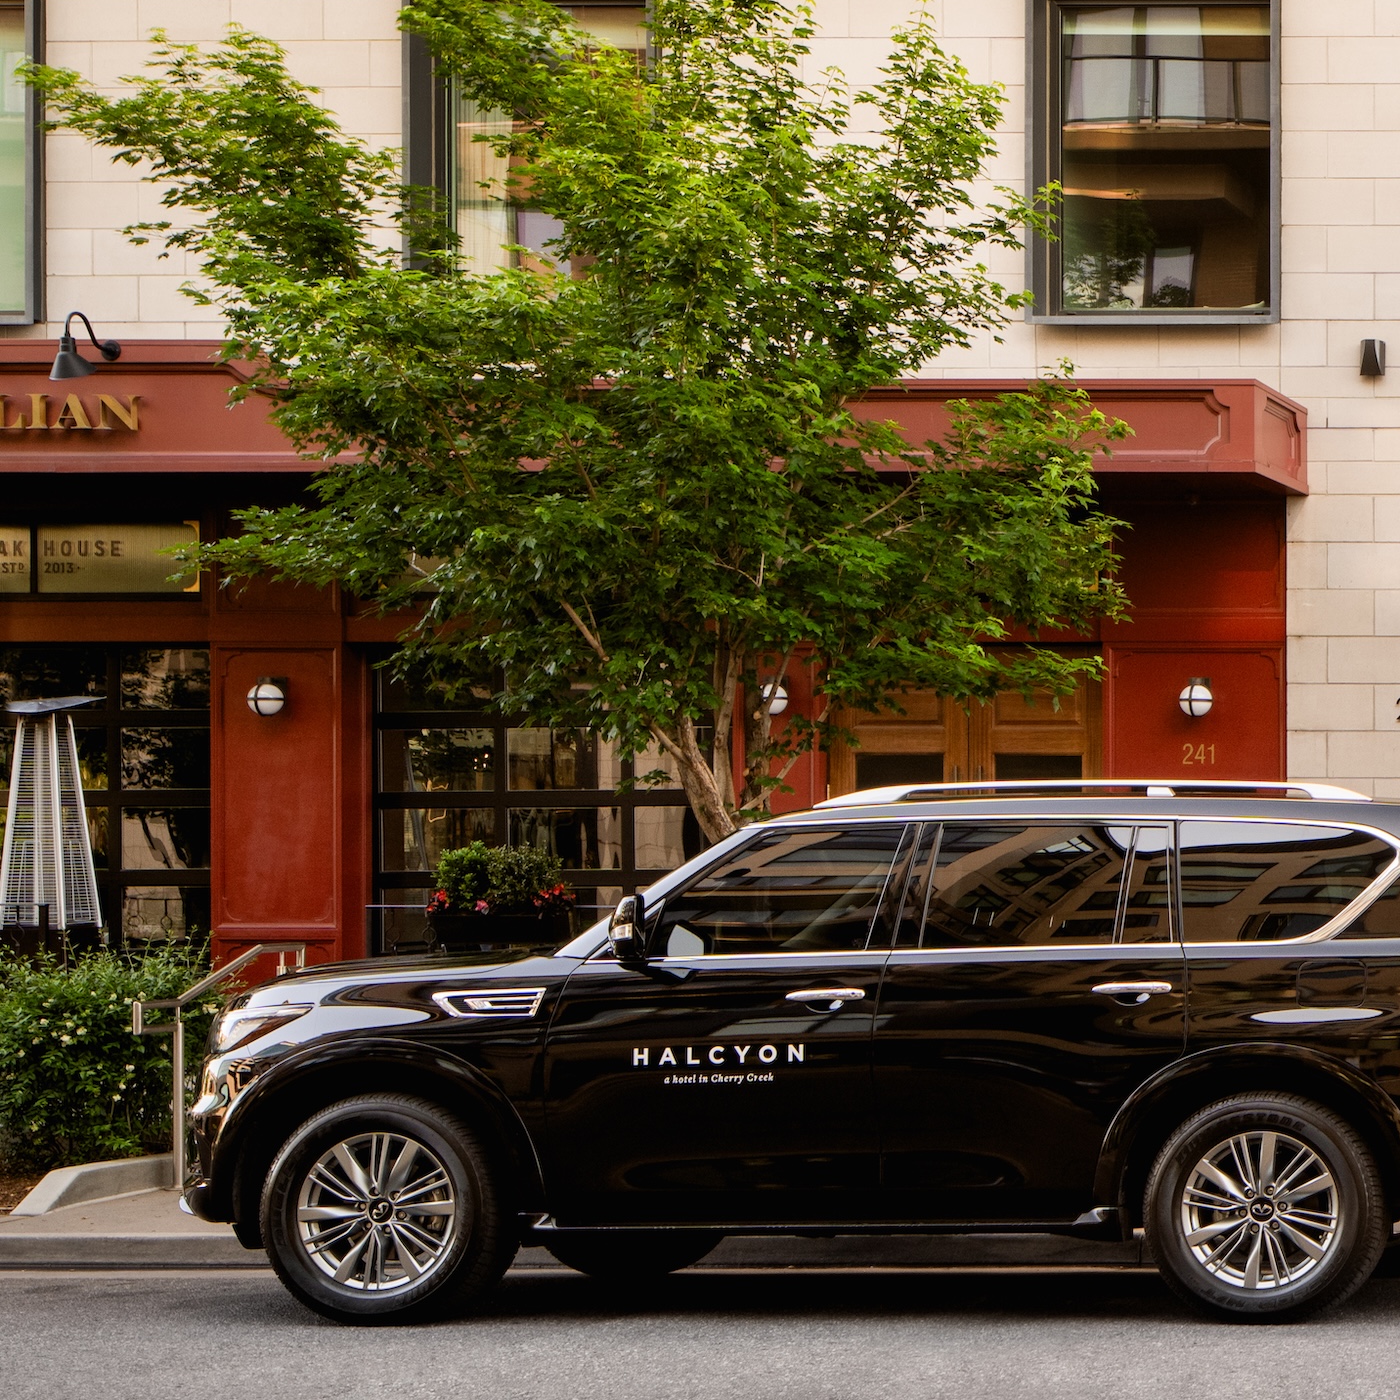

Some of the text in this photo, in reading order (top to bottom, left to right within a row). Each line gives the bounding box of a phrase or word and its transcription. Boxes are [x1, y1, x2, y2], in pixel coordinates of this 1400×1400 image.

[43, 540, 122, 557] HOUSE
[1182, 743, 1216, 765] 241
[632, 1043, 805, 1066] HALCYON
[663, 1072, 775, 1084] a hotel in Cherry Creek
